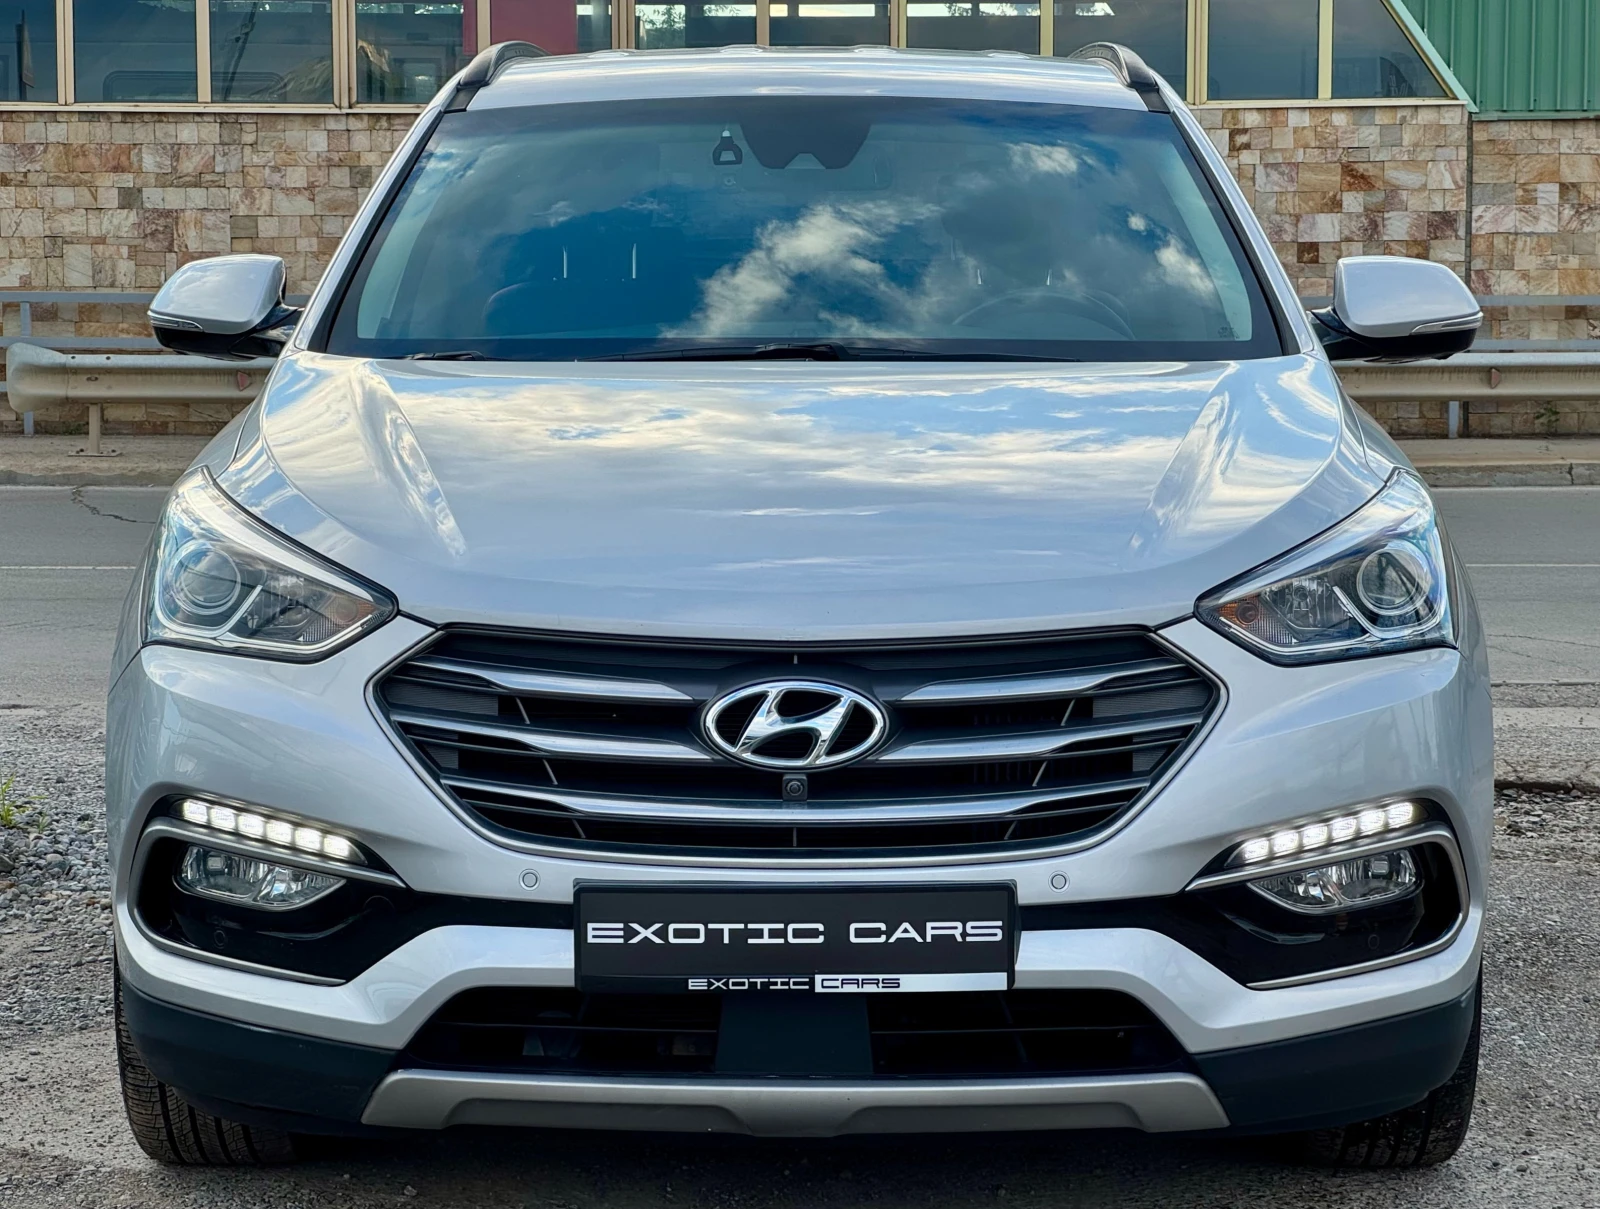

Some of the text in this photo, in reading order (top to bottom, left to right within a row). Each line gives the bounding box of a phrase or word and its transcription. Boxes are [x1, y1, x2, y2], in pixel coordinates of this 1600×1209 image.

[586, 920, 1003, 944] EXOTIC CARS
[688, 977, 901, 990] EXOTIC CARS
